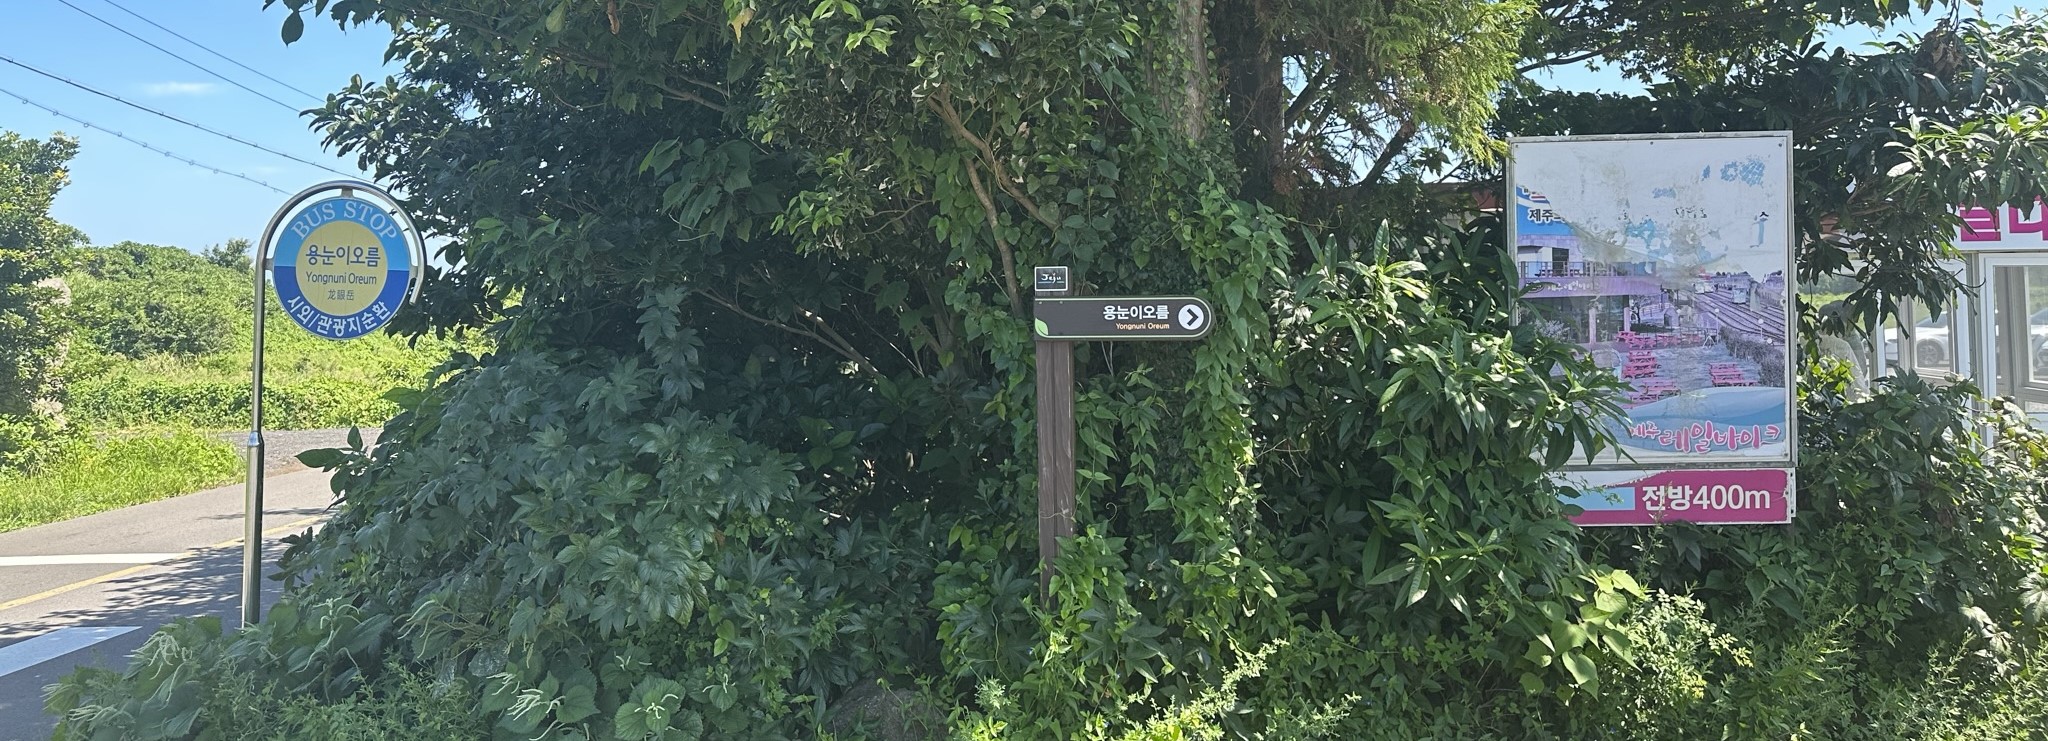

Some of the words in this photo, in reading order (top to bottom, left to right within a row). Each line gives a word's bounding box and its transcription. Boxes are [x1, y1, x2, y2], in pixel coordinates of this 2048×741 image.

[290, 203, 336, 240] BUS
[343, 201, 398, 240] STOP
[1529, 208, 1564, 222] 제주
[306, 244, 381, 267] 용눈이오름
[305, 271, 347, 285] Yongnuni
[348, 272, 377, 285] Oreum
[1041, 272, 1062, 283] Jeju
[287, 296, 391, 337] 시외/관광지순환
[1103, 305, 1170, 320] 용눈이오름
[1116, 322, 1146, 331] Yongnuni
[1147, 322, 1170, 330] Oreum
